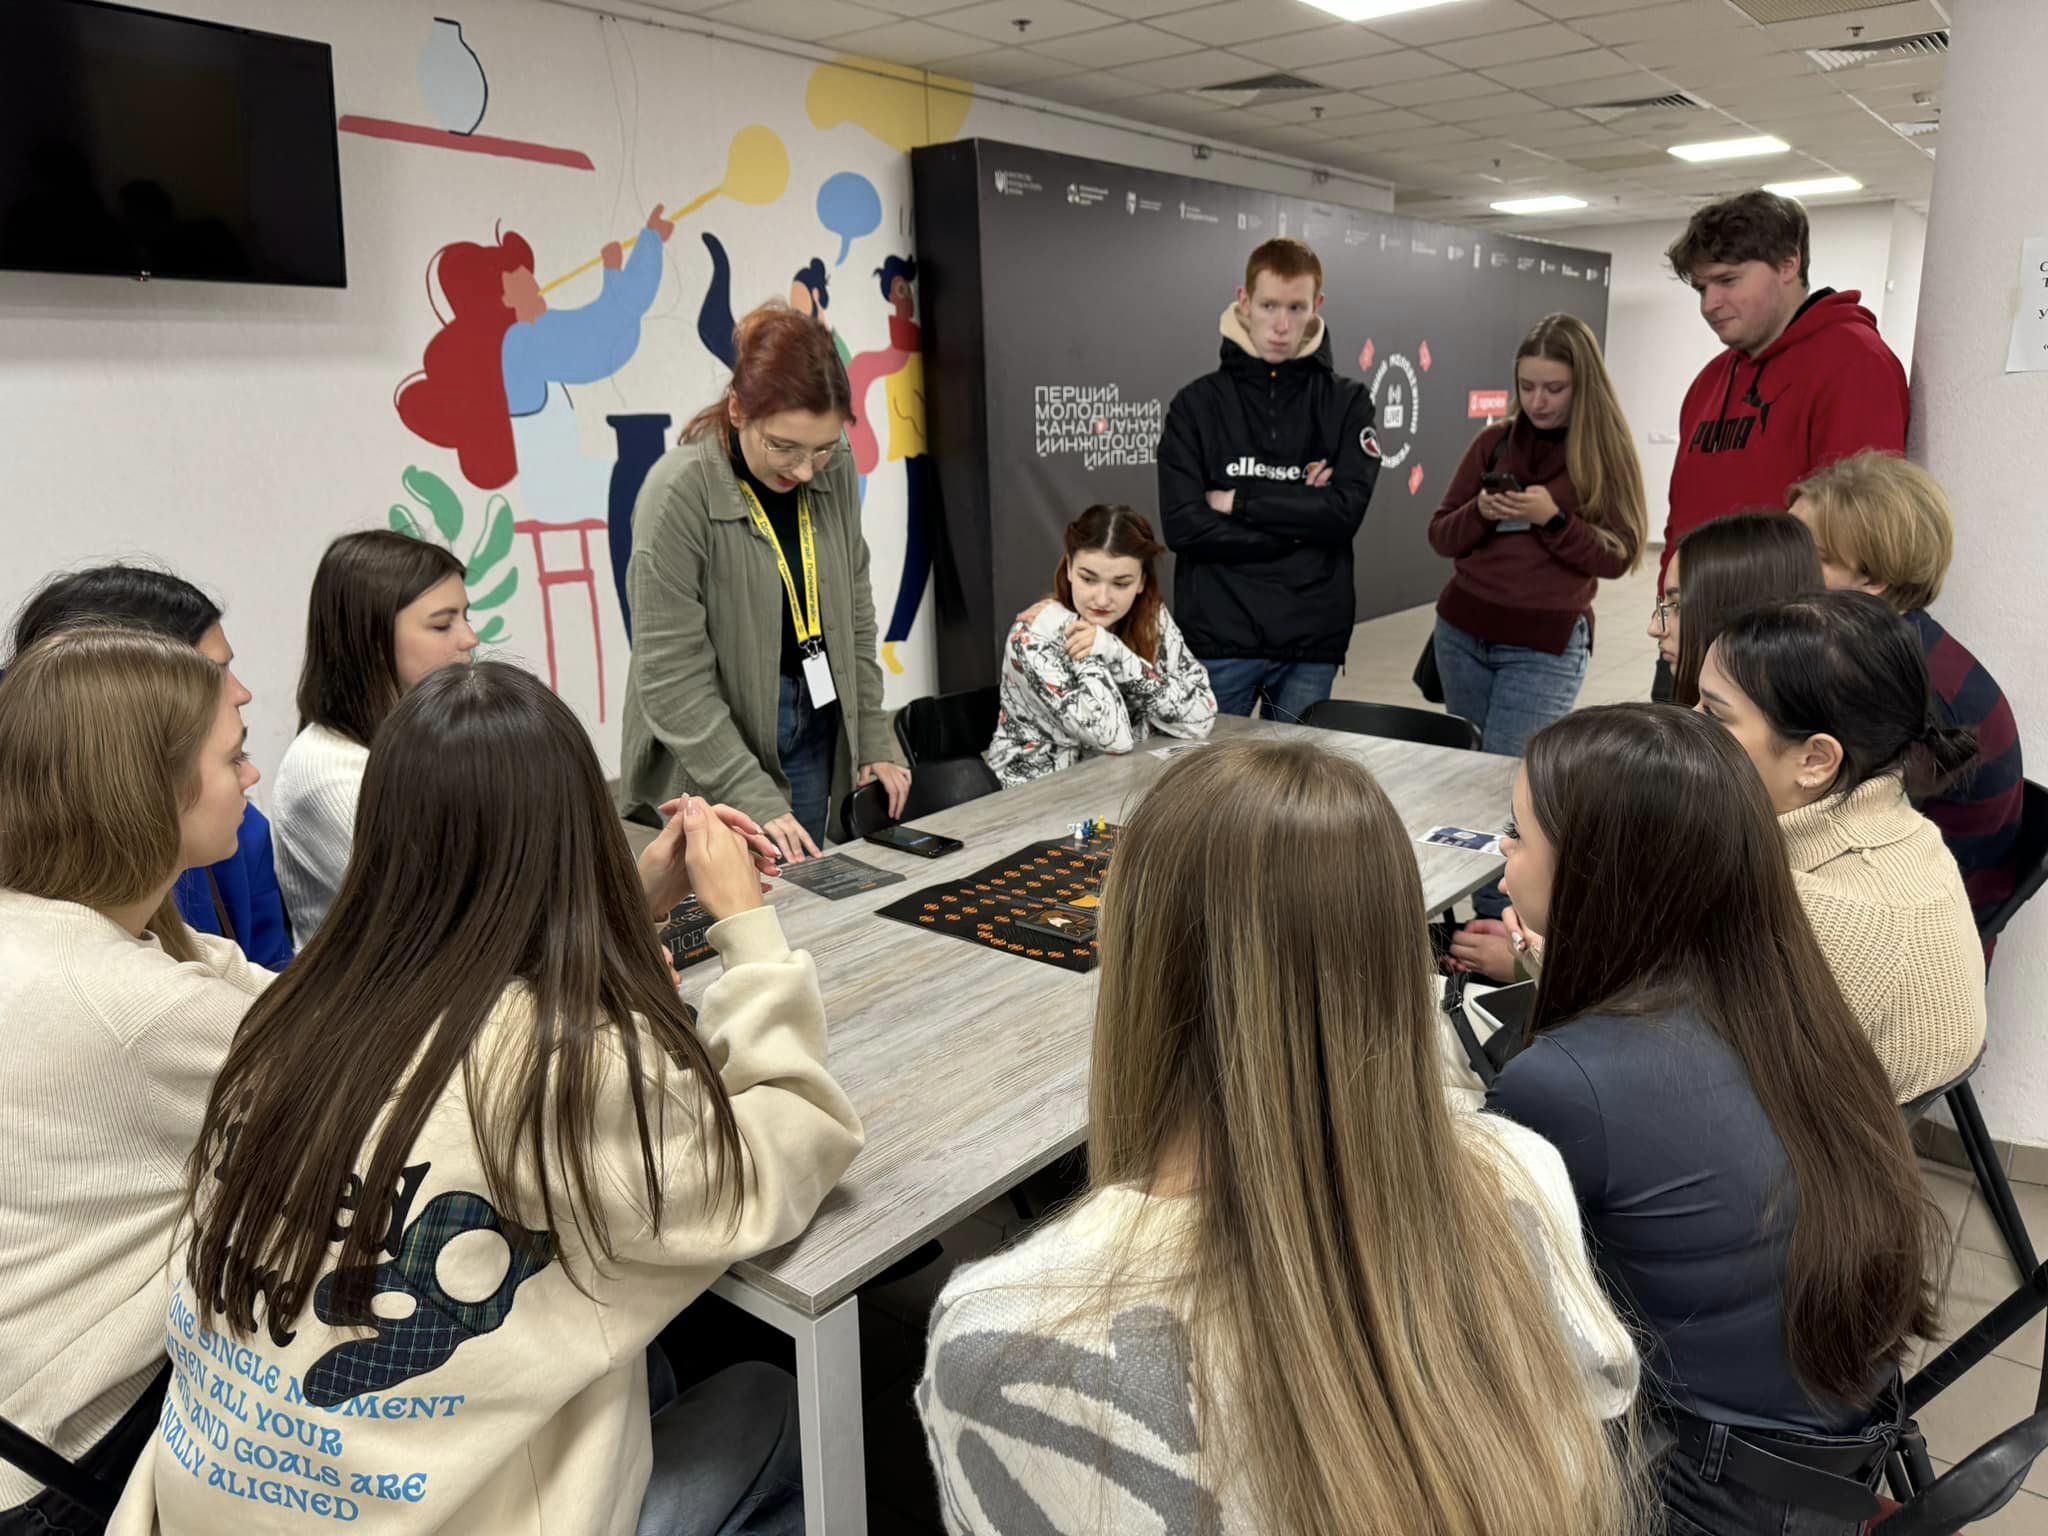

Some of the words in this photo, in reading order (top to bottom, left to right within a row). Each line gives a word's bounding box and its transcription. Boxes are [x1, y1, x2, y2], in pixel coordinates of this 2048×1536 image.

[1035, 383, 1119, 402] ПЕРШИЙ
[1035, 399, 1161, 421] МОЛОДІЖНИЙ
[1687, 415, 1757, 453] PUMA
[1225, 457, 1301, 480] ellesse
[169, 1292, 196, 1340] ONE
[198, 1325, 281, 1394] SINGLE
[284, 1376, 465, 1420] MMENT
[210, 1374, 249, 1423] ALL
[255, 1401, 344, 1457] YOUR
[190, 1398, 229, 1451] AND
[233, 1436, 342, 1488] GOALS
[350, 1472, 428, 1503] ARE
[208, 1462, 360, 1522] ALIGNED
